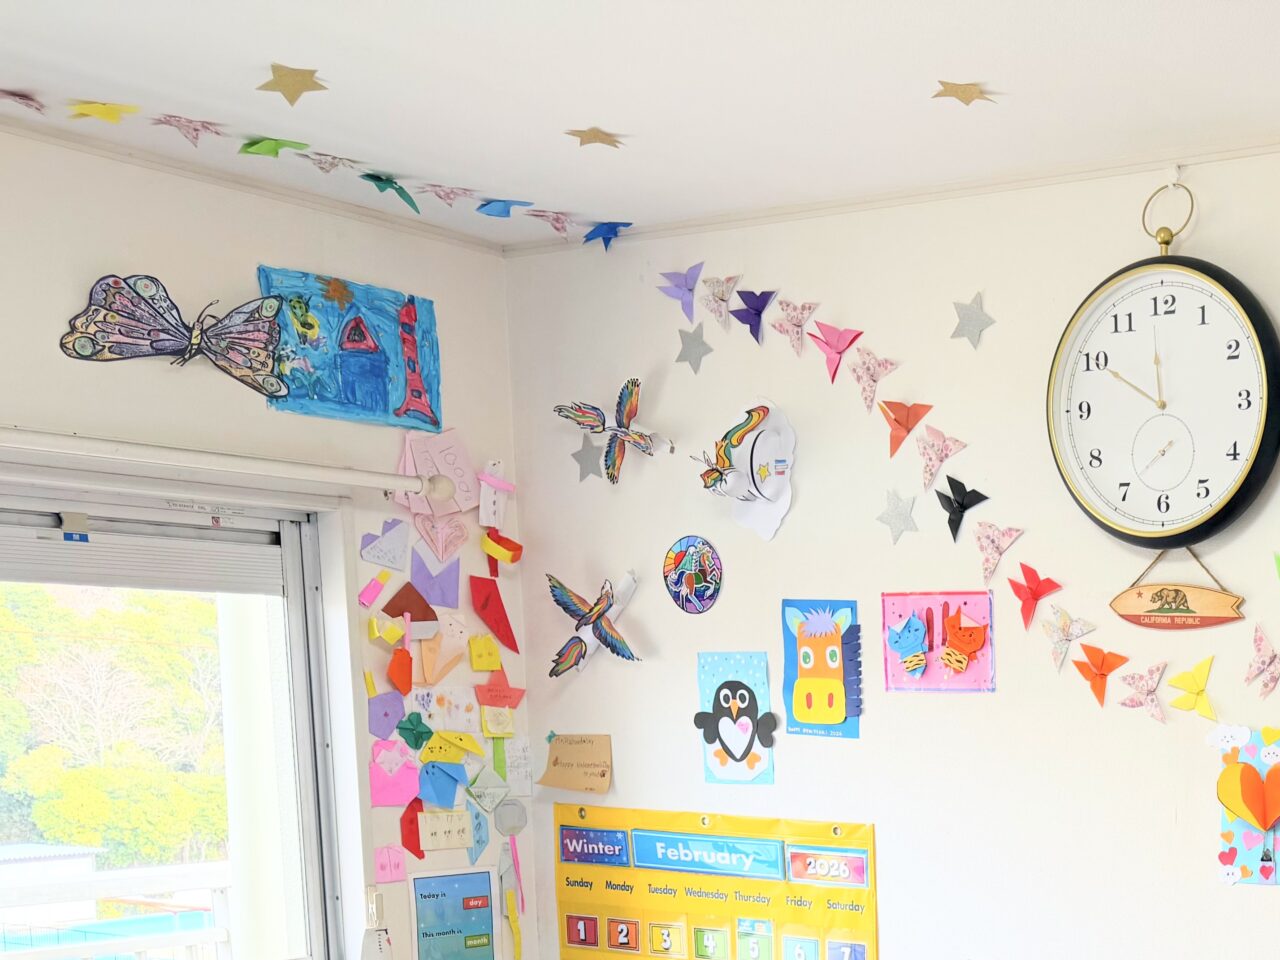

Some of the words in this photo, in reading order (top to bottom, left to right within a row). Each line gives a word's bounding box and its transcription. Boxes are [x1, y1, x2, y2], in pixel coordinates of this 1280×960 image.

[1150, 294, 1176, 317] 12
[1197, 305, 1210, 326] 1
[1110, 313, 1137, 334] 11
[1226, 339, 1241, 360] 2
[1083, 350, 1109, 372] 10
[1078, 400, 1092, 421] 9
[1237, 389, 1252, 411] 3
[1089, 448, 1104, 469] 8
[1225, 440, 1241, 462] 4
[1118, 482, 1132, 502] 7
[1196, 478, 1211, 500] 5
[1156, 493, 1171, 514] 6
[1140, 616, 1171, 625] CALIFORNIA
[1174, 617, 1201, 625] REPUBLIC
[565, 838, 623, 856] Winter
[655, 841, 755, 872] February
[805, 857, 851, 879] 2026
[420, 892, 440, 900] Today
[469, 899, 483, 907] day
[565, 876, 594, 891] Sunday
[605, 880, 635, 895] Monday
[647, 883, 678, 898] Tuesday
[684, 887, 729, 902] Wednesday
[734, 891, 772, 907] Thursday
[785, 895, 813, 910] Friday
[826, 899, 865, 915] Saturday
[467, 937, 488, 946] month
[577, 920, 586, 941] 1
[617, 924, 630, 945] 2
[661, 929, 672, 950] 3
[703, 933, 716, 955] 4
[749, 939, 760, 959] 5
